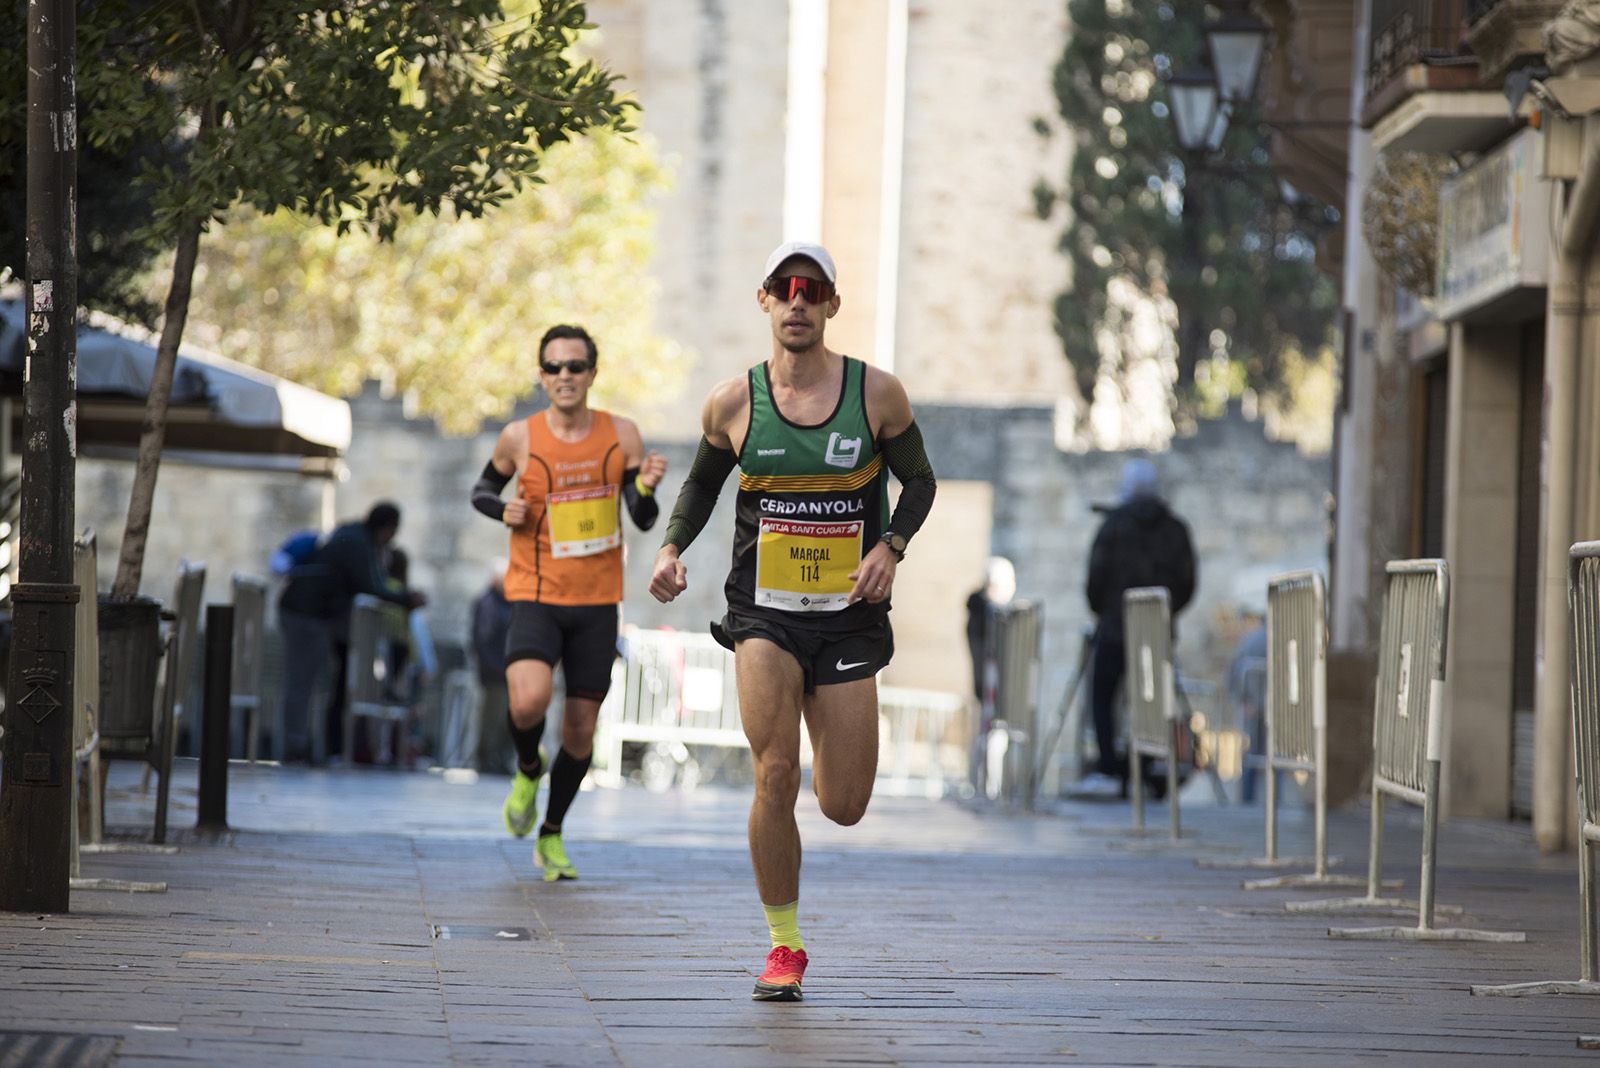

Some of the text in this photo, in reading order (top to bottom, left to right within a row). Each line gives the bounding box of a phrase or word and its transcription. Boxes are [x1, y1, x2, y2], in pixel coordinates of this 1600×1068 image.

[759, 498, 864, 514] CERDANYOLA
[791, 525, 816, 534] SANT
[816, 526, 846, 535] CUGAT
[790, 546, 831, 565] MARÇAL
[800, 565, 820, 582] 114
